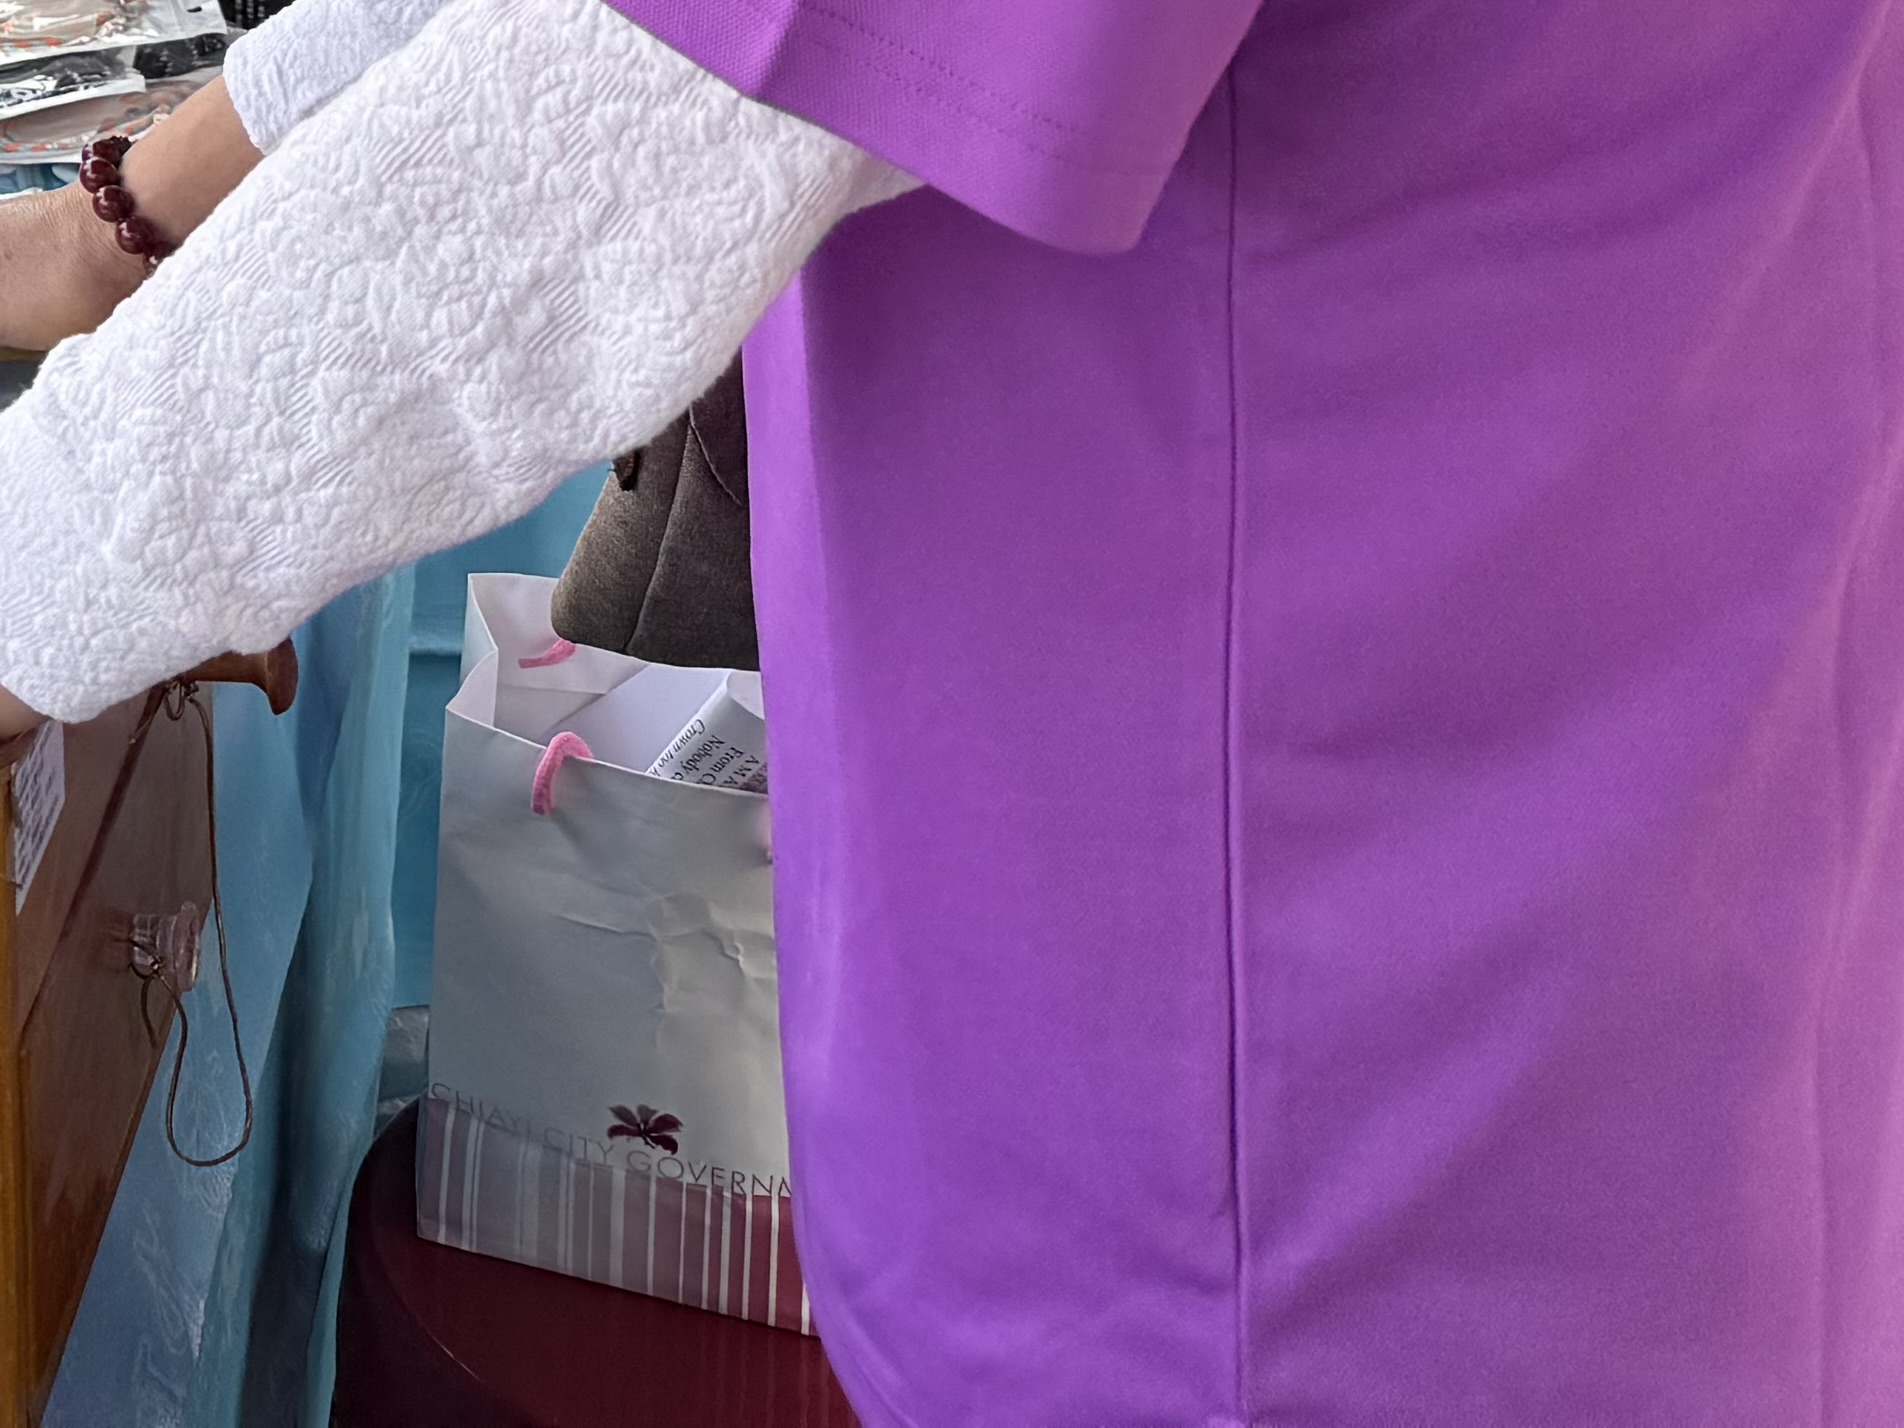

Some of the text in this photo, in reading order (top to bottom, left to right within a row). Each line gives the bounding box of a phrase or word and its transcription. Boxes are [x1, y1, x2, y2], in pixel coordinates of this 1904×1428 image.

[673, 719, 705, 752] Crown
[680, 735, 725, 774] Nobody
[710, 747, 745, 773] From
[430, 1081, 532, 1137] CHIAYI
[543, 1125, 614, 1162] CITY
